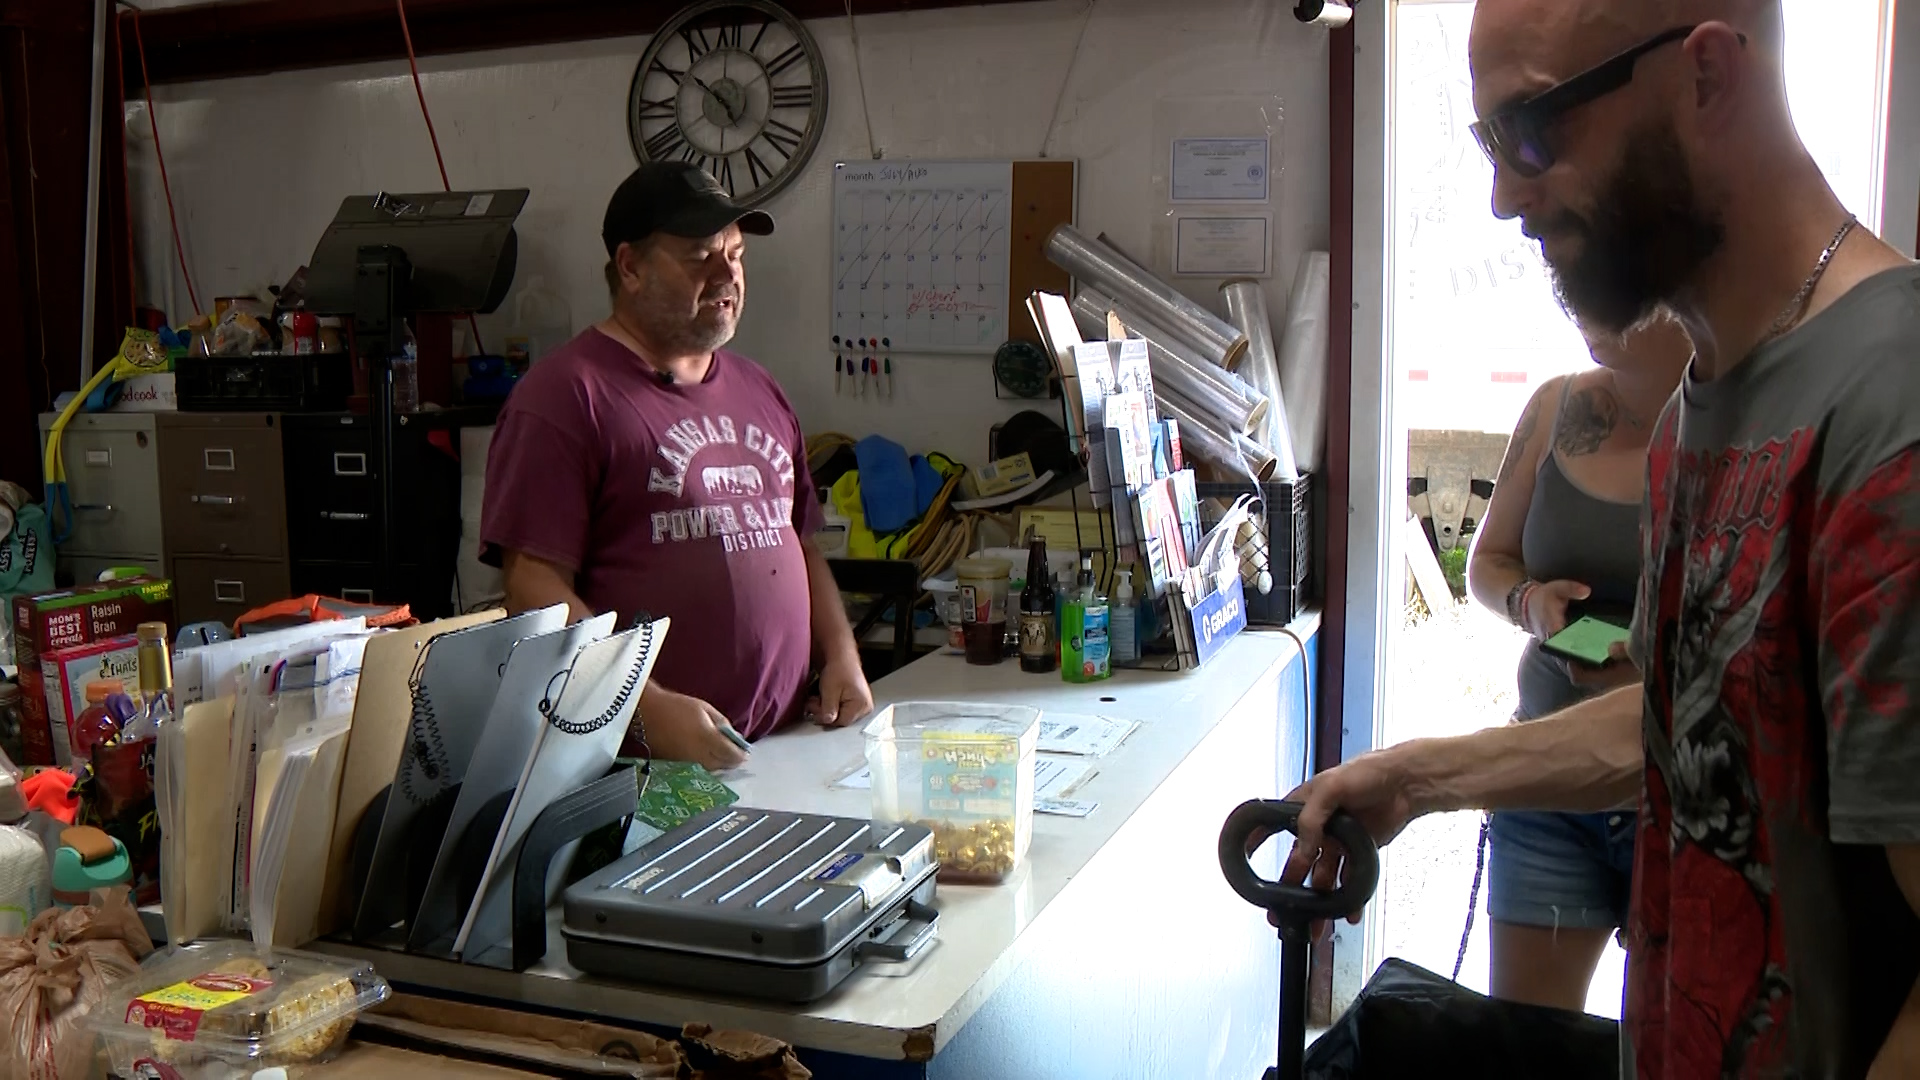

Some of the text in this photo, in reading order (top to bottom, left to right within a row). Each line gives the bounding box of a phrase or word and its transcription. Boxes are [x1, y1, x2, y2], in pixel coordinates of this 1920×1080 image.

[647, 414, 796, 498] KANSAS CITY
[650, 502, 743, 545] POWER
[741, 502, 766, 530] &
[721, 529, 783, 552] DISTRICT
[91, 603, 122, 619] Raisin
[1210, 597, 1239, 635] GRACO
[49, 623, 81, 637] BEST
[93, 620, 117, 635] Bran
